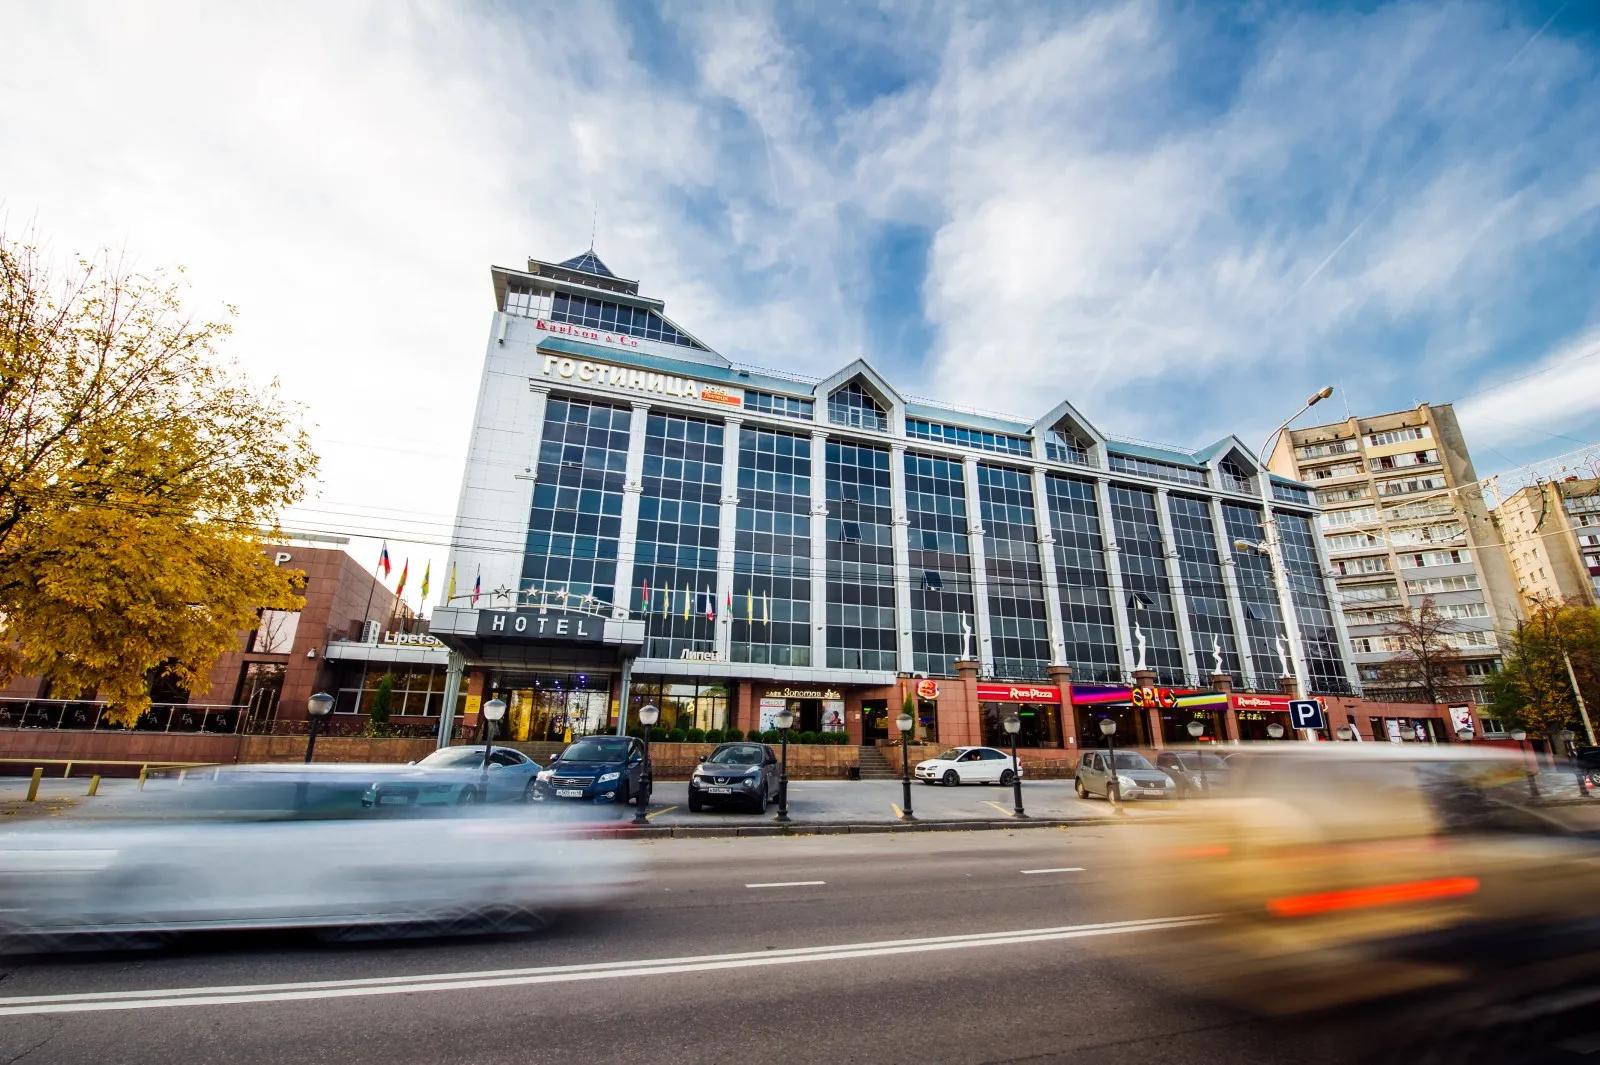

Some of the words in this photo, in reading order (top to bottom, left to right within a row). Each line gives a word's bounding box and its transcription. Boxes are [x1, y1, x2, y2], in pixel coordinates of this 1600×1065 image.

[620, 335, 638, 347] Co
[543, 355, 698, 400] ГОСТИНИЦА
[492, 614, 588, 636] HOTEL
[680, 648, 723, 662] Липец
[1297, 703, 1315, 726] P
